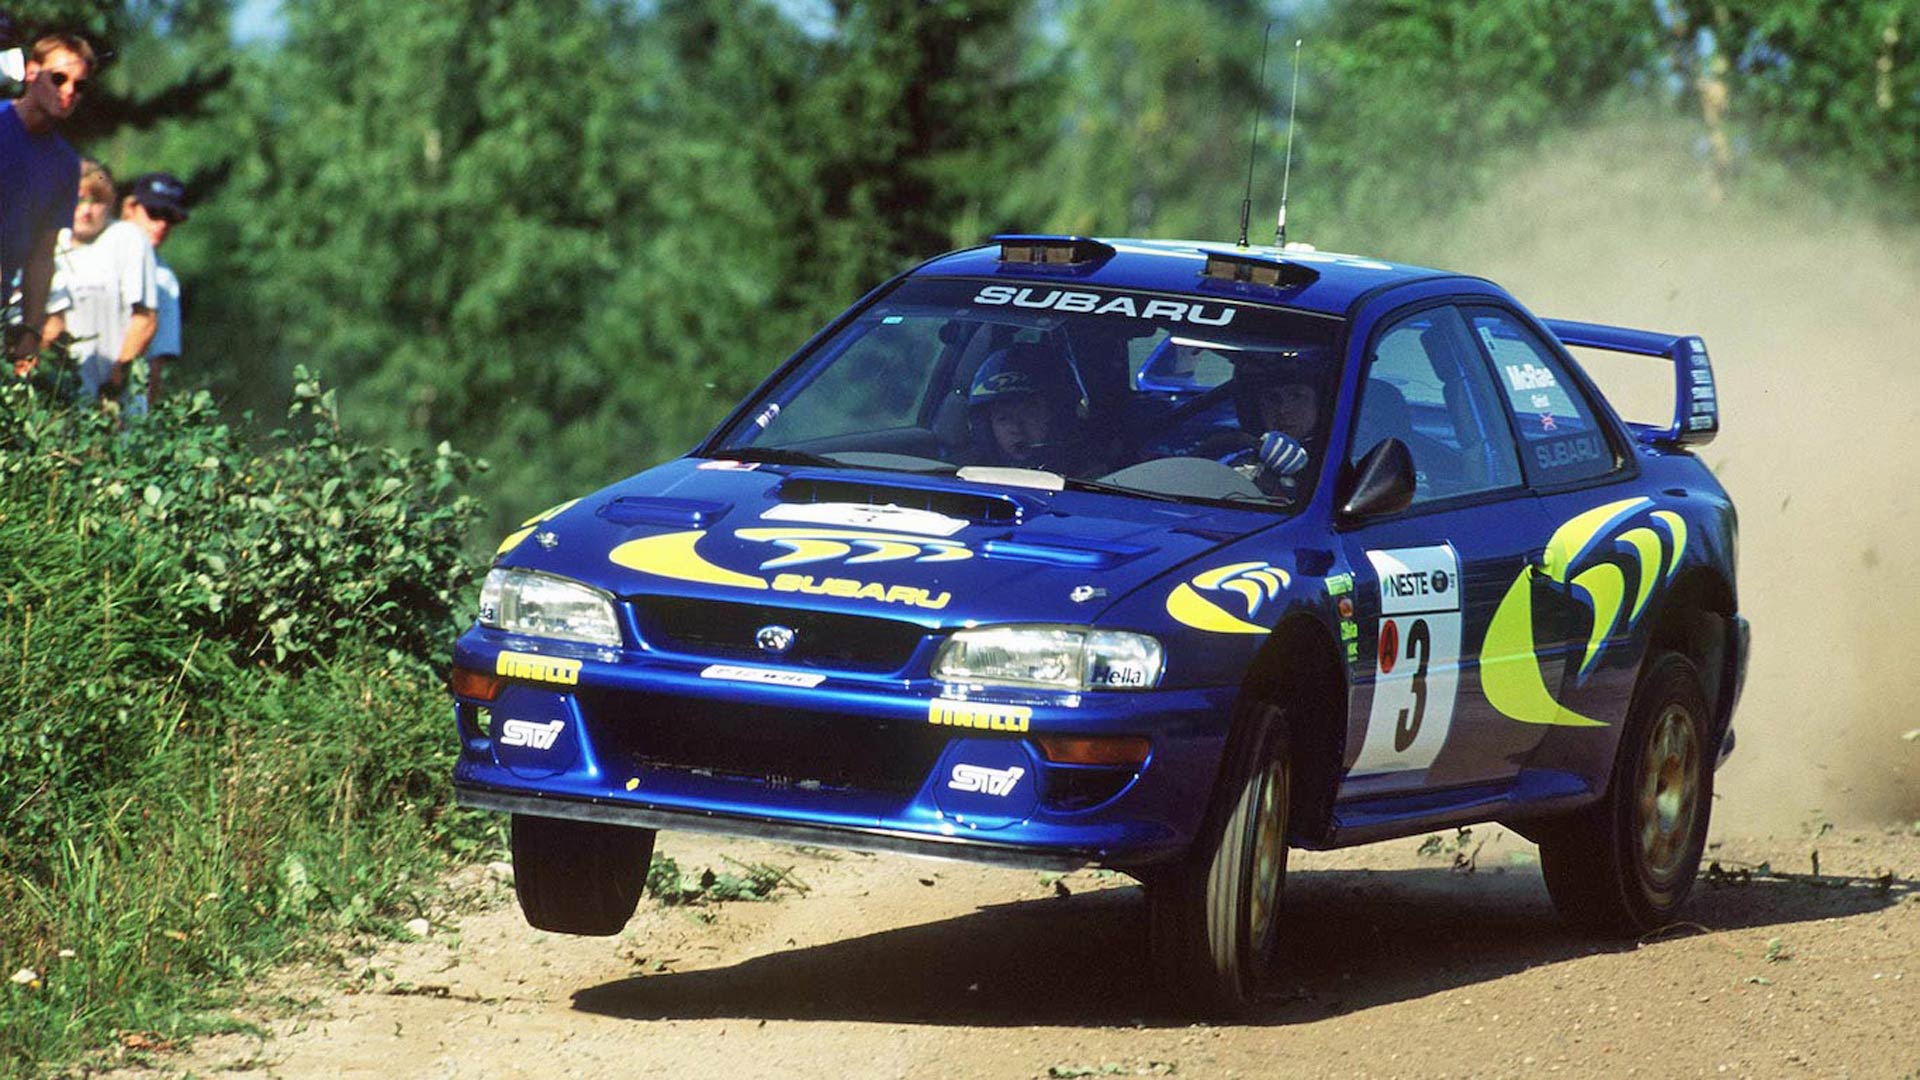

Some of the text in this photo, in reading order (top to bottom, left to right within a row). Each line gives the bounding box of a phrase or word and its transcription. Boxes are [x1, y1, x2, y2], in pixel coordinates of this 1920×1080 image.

[974, 286, 1236, 326] SUBARU
[1506, 363, 1555, 390] McRae
[1536, 436, 1600, 469] SUBARU
[772, 573, 951, 610] SUBARU
[1389, 572, 1429, 597] NESTE
[496, 650, 583, 685] PIRELLI
[1091, 666, 1142, 685] Hella
[1395, 618, 1430, 753] 3
[928, 698, 1032, 732] PIRELLI
